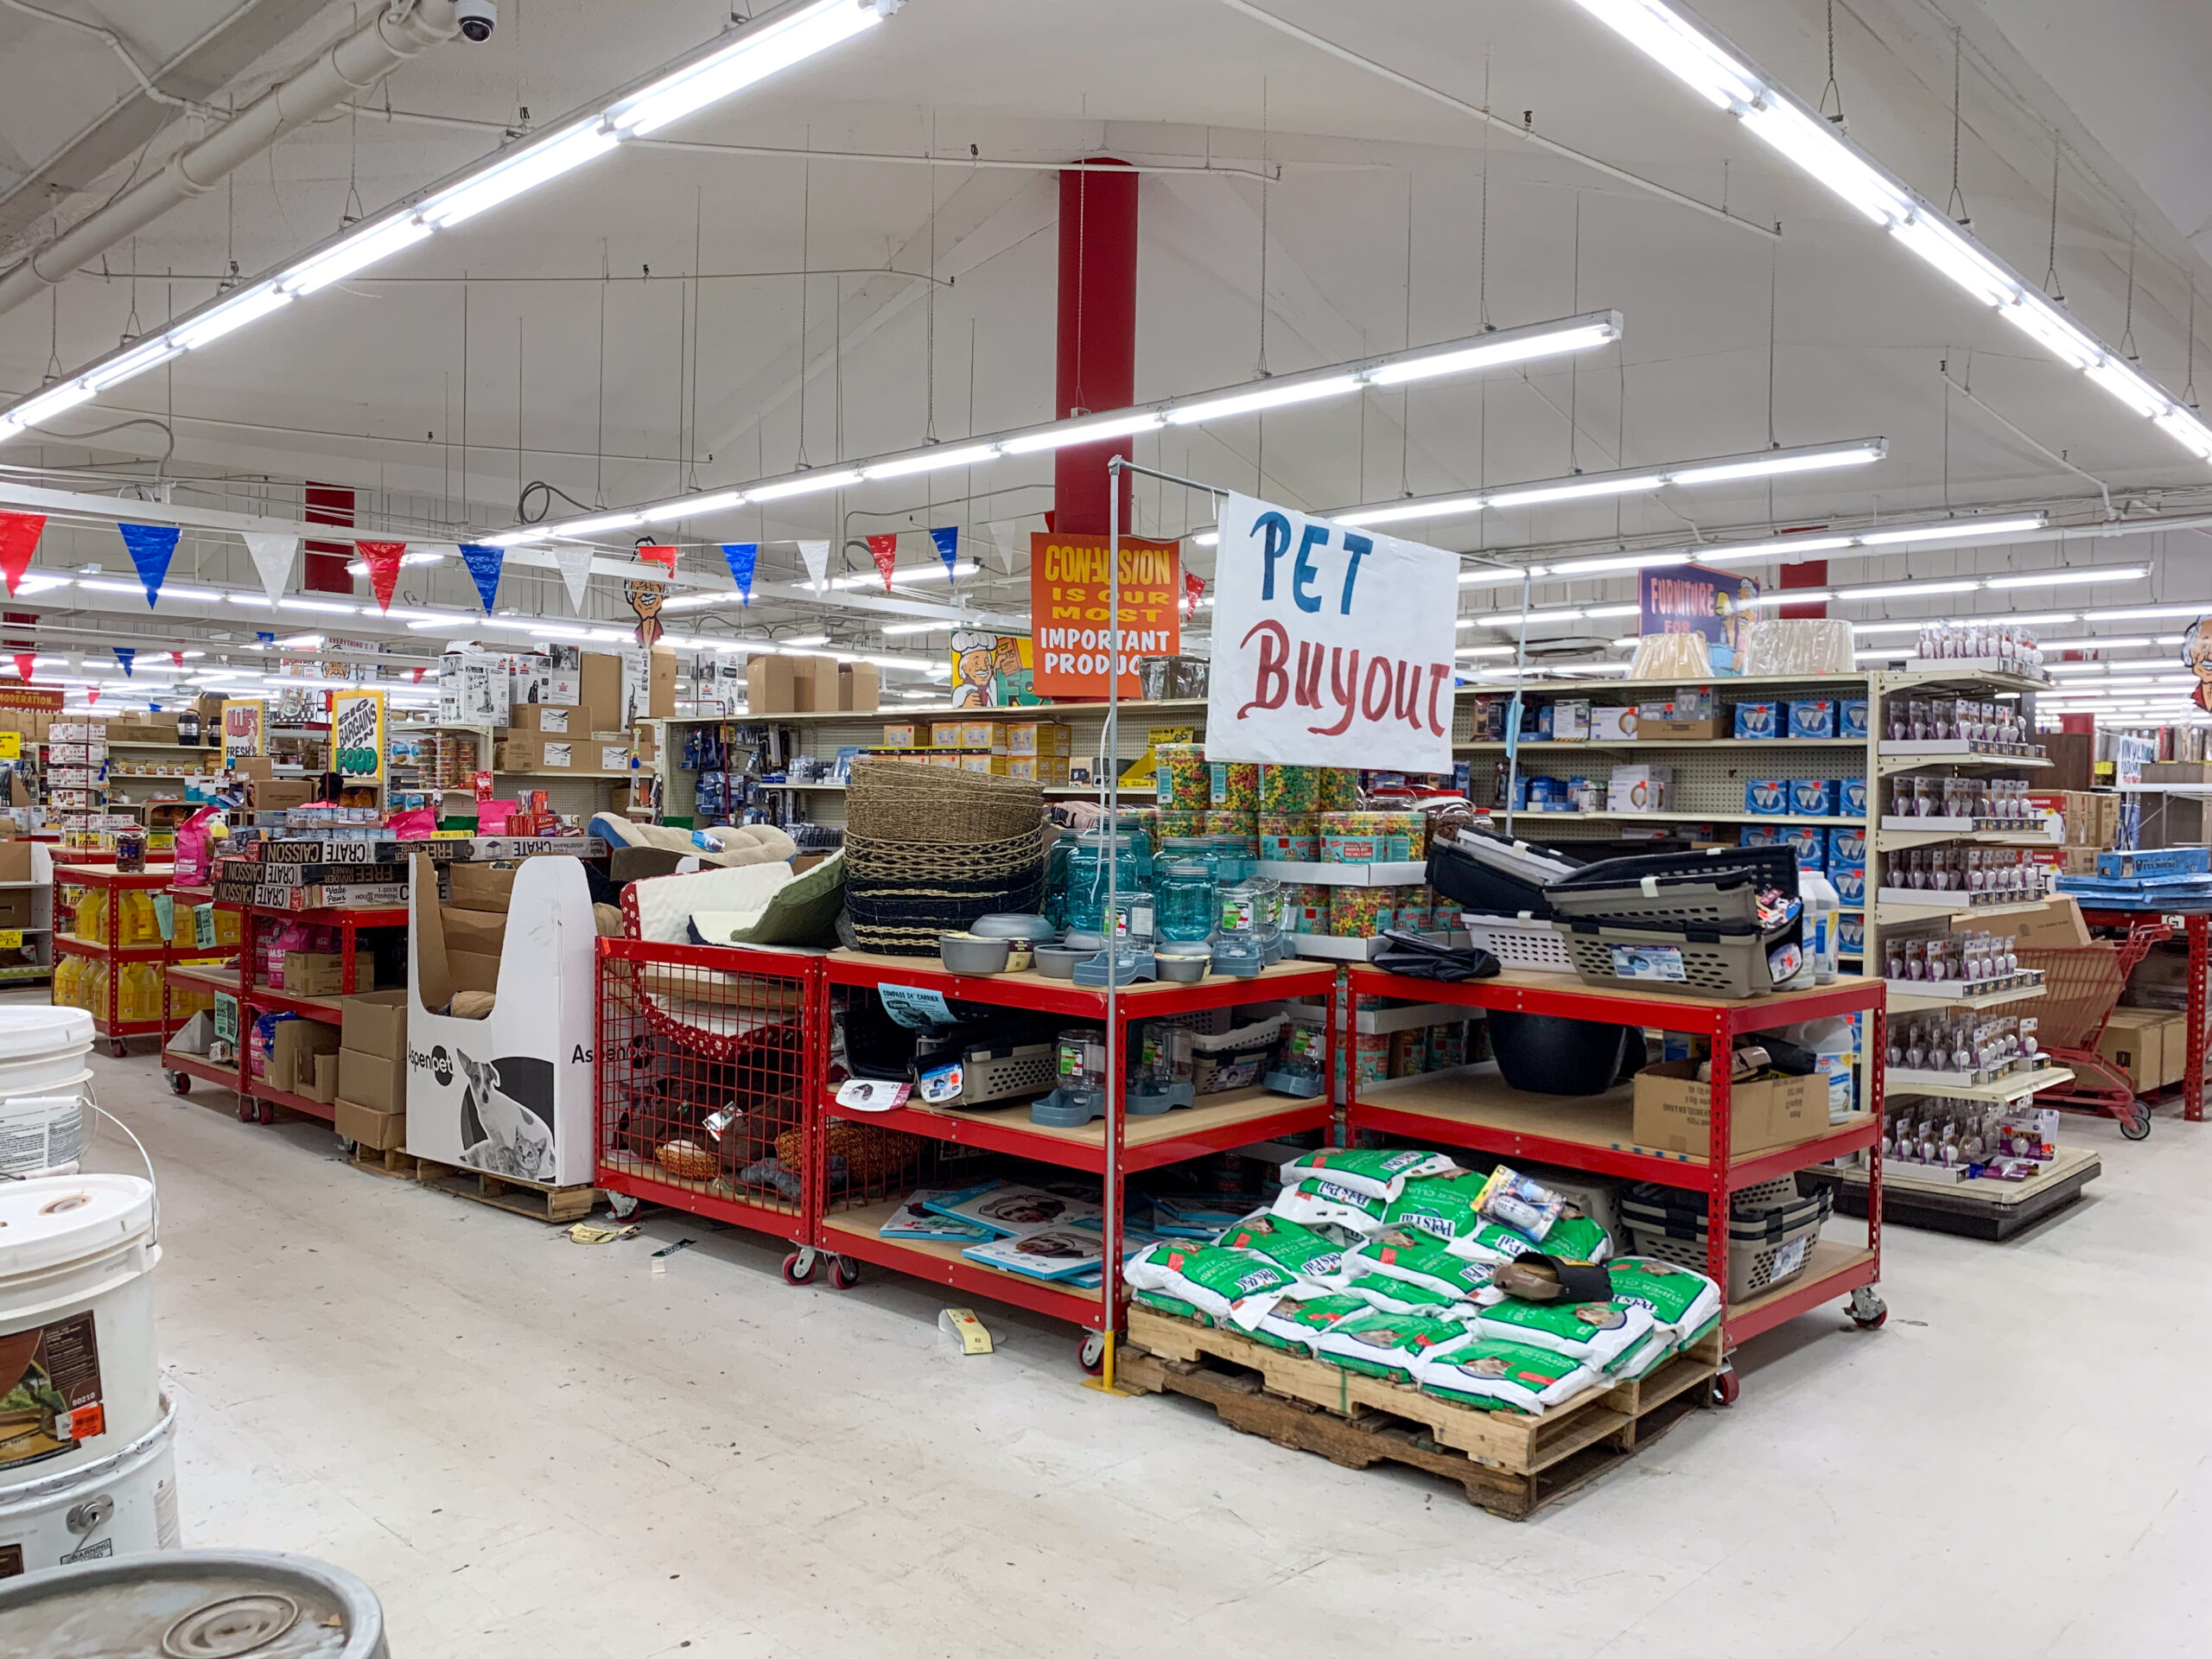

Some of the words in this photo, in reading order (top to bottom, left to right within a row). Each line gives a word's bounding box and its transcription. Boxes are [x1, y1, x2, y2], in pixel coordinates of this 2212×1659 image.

[1249, 511, 1373, 615] PET
[1052, 587, 1086, 601] IS
[1098, 589, 1170, 605] OUR
[1650, 576, 1715, 617] FURNITURE
[1052, 606, 1164, 623] MOST
[1664, 620, 1692, 634] FOR
[1040, 627, 1170, 652] IMPORTANT
[1044, 653, 1141, 676] PRODUC
[338, 698, 369, 727] BIG
[338, 702, 378, 748] BARGAINS
[352, 729, 374, 748] ON
[226, 746, 250, 758] FRESH
[336, 747, 378, 776] FOOD
[267, 842, 320, 863] CAISSON
[326, 843, 365, 862] CRATE
[513, 841, 551, 856] CRATE
[228, 863, 264, 882] CAISSON
[269, 865, 295, 885] CRATE
[325, 874, 353, 883] DIVIDER
[356, 866, 392, 882] FREE
[218, 883, 254, 903] CAISSON
[257, 887, 284, 906] CRATE
[326, 885, 346, 895] Value
[327, 894, 346, 904] Paws
[883, 989, 906, 998] COMPASS
[917, 994, 940, 1003] CARRIER
[72, 1391, 96, 1407] 80210
